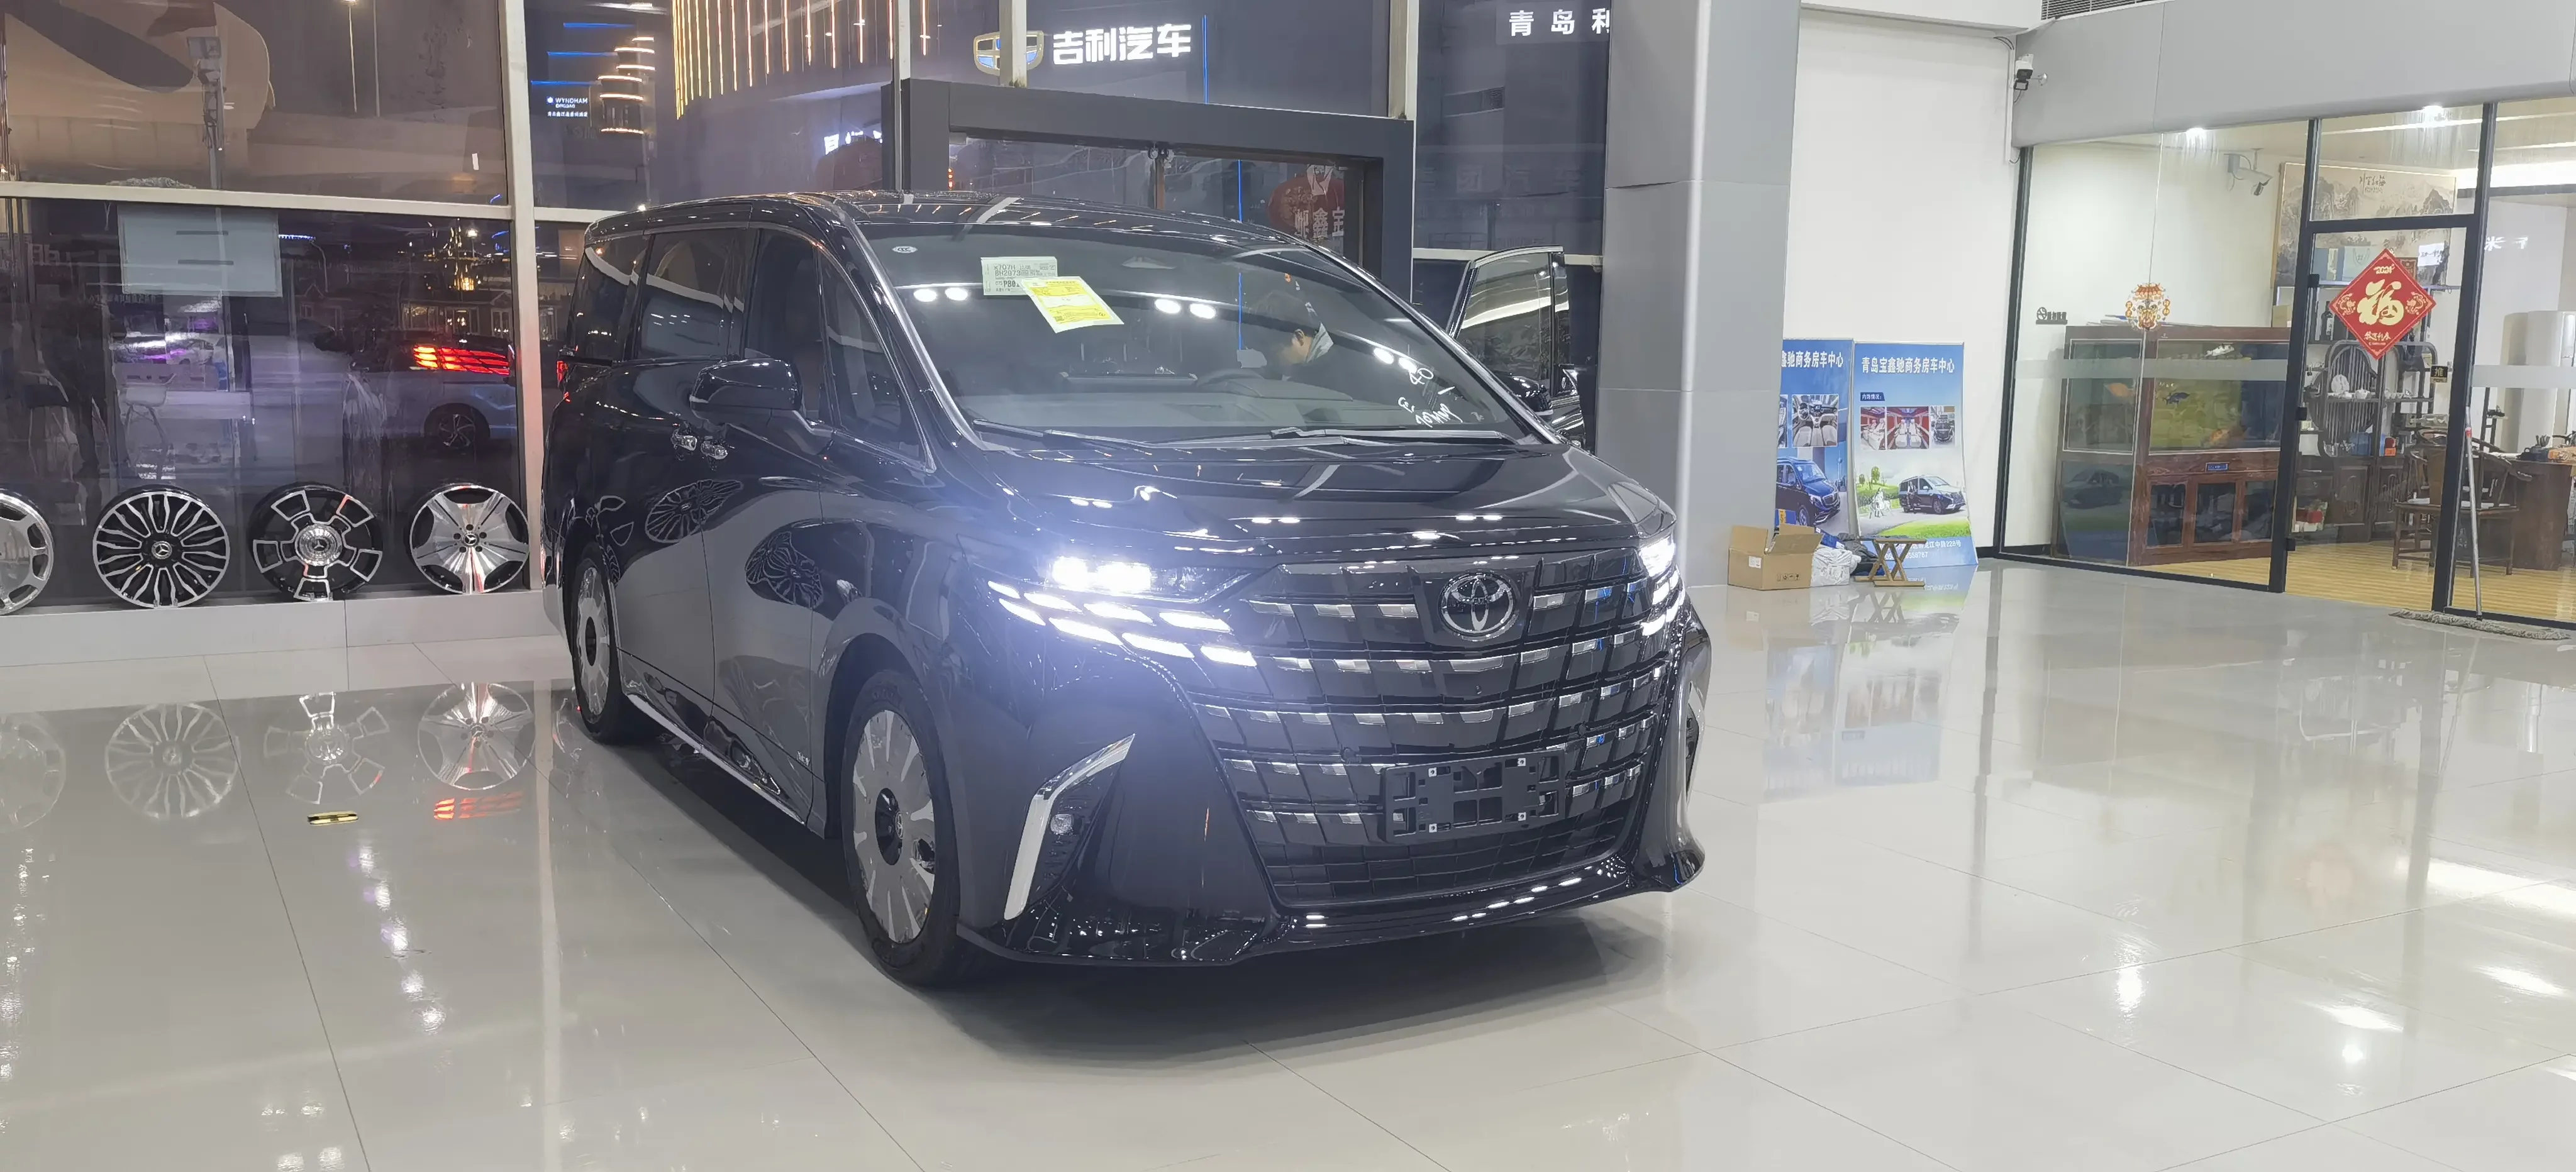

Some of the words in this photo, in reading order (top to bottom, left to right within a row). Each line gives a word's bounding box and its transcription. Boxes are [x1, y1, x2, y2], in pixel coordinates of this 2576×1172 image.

[1053, 23, 1192, 65] 吉利汽车
[2357, 279, 2404, 326] 福
[1861, 357, 1955, 373] 青岛宝鑫驰商务房车中心
